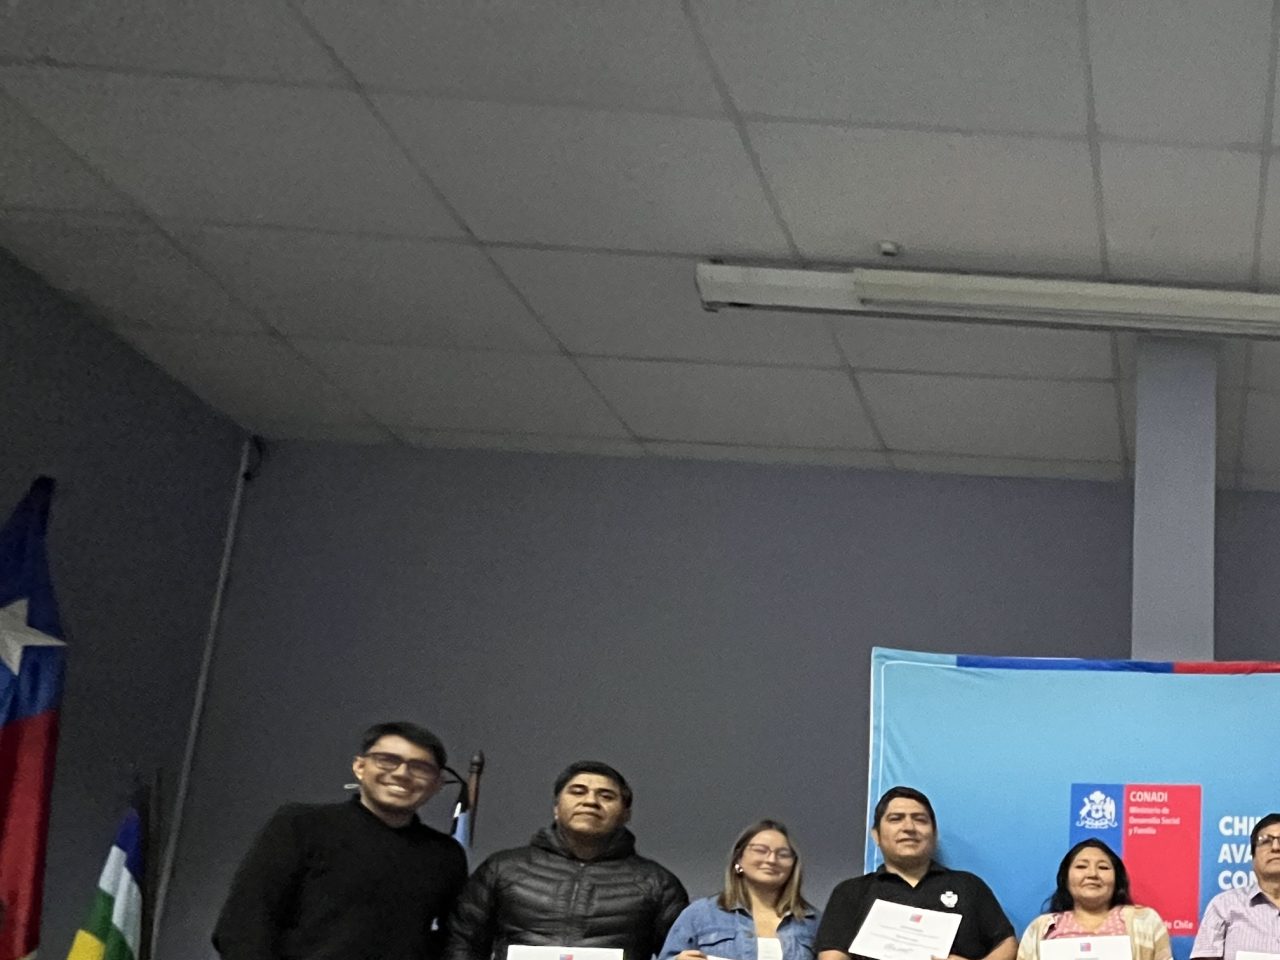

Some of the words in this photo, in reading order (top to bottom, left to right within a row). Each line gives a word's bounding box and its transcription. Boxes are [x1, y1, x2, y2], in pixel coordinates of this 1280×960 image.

[1129, 791, 1168, 802] CONADI
[1219, 815, 1262, 836] CHI
[1174, 920, 1193, 929] Chile
